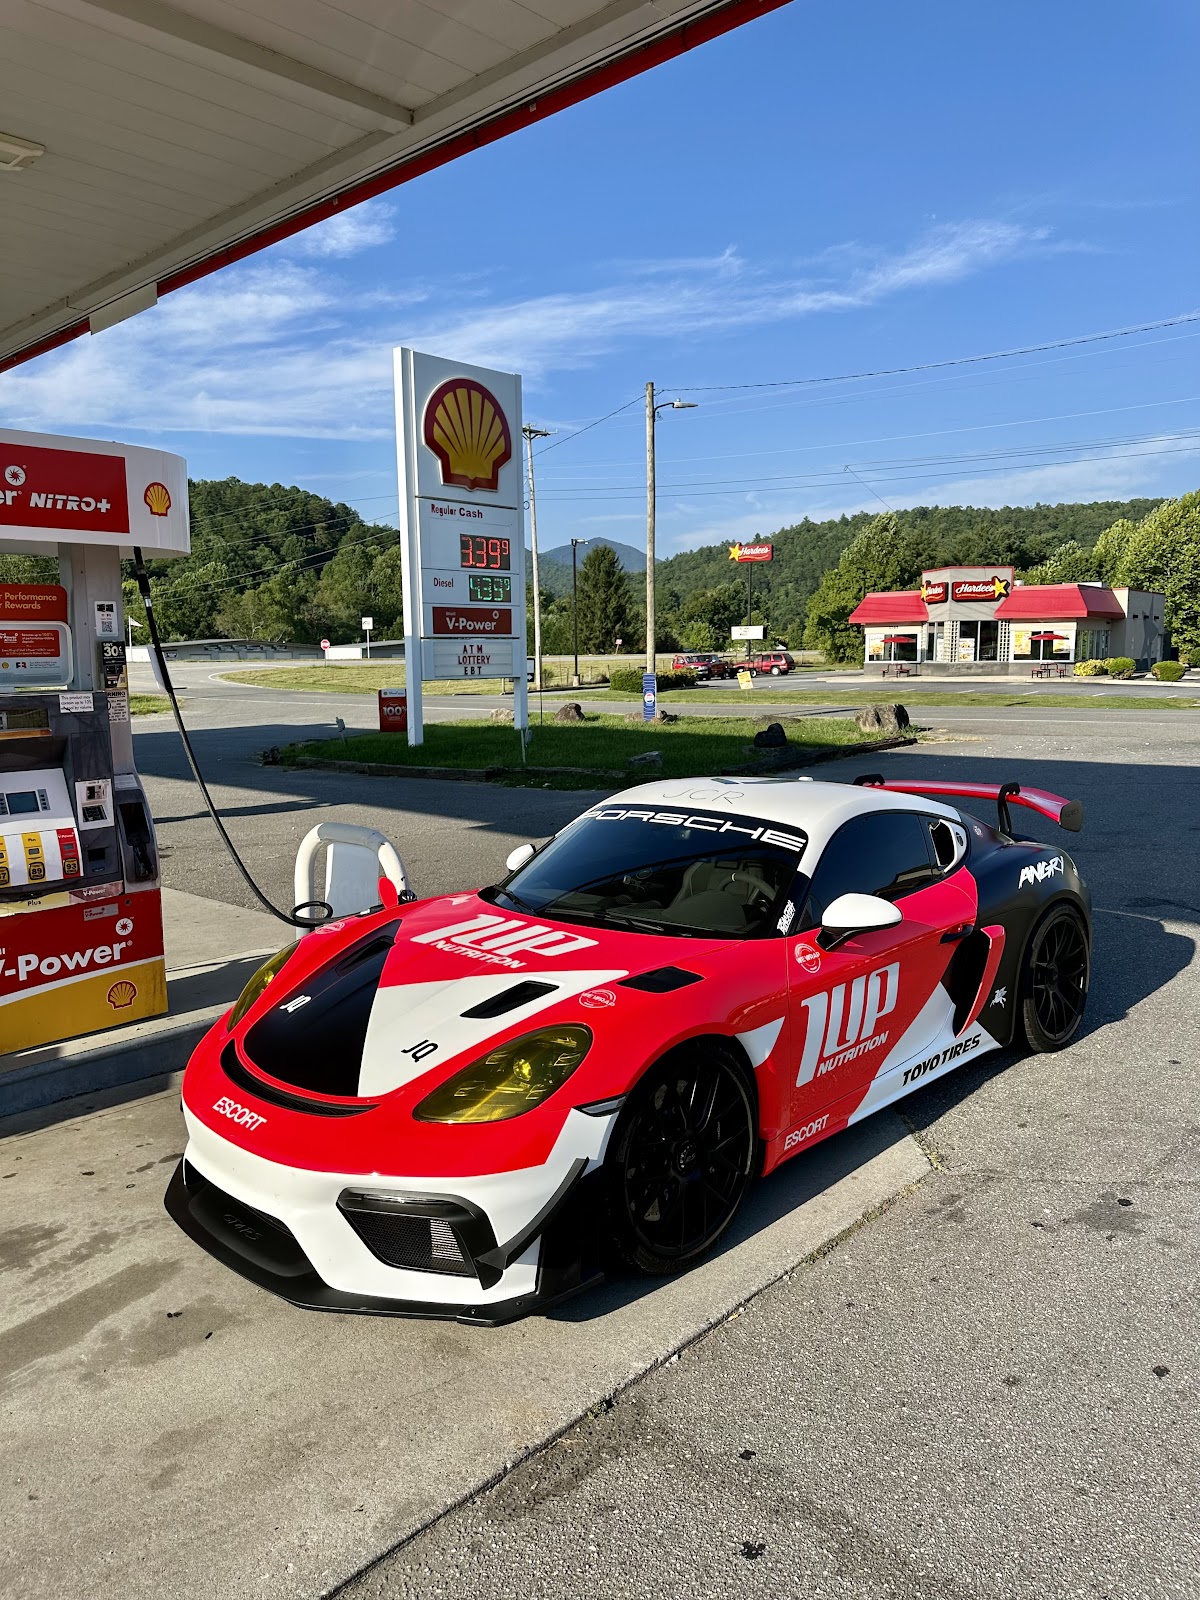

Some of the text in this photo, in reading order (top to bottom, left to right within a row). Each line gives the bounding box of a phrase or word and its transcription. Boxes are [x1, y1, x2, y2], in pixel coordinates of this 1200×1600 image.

[431, 504, 483, 519] Regular Cash
[433, 577, 454, 588] Diesel
[955, 583, 995, 594] Hardee's
[4, 592, 57, 601] Performance
[4, 601, 41, 610] Rewards
[446, 617, 497, 631] V-Power
[457, 655, 491, 665] LOTTERY
[663, 787, 744, 804] JCR
[583, 808, 807, 852] PORSCHE
[31, 867, 42, 875] 89
[66, 863, 77, 871] 93
[1018, 855, 1064, 889] ANGRY
[410, 914, 600, 957] 1UP
[0, 940, 127, 981] -Power
[430, 940, 527, 969] NUTRITION
[796, 962, 900, 1088] 1UP
[817, 1031, 889, 1077] NUTRITION
[902, 1033, 982, 1087] TOYO TIRES
[212, 1096, 268, 1131] ESCORT
[784, 1114, 830, 1150] ESCORT
